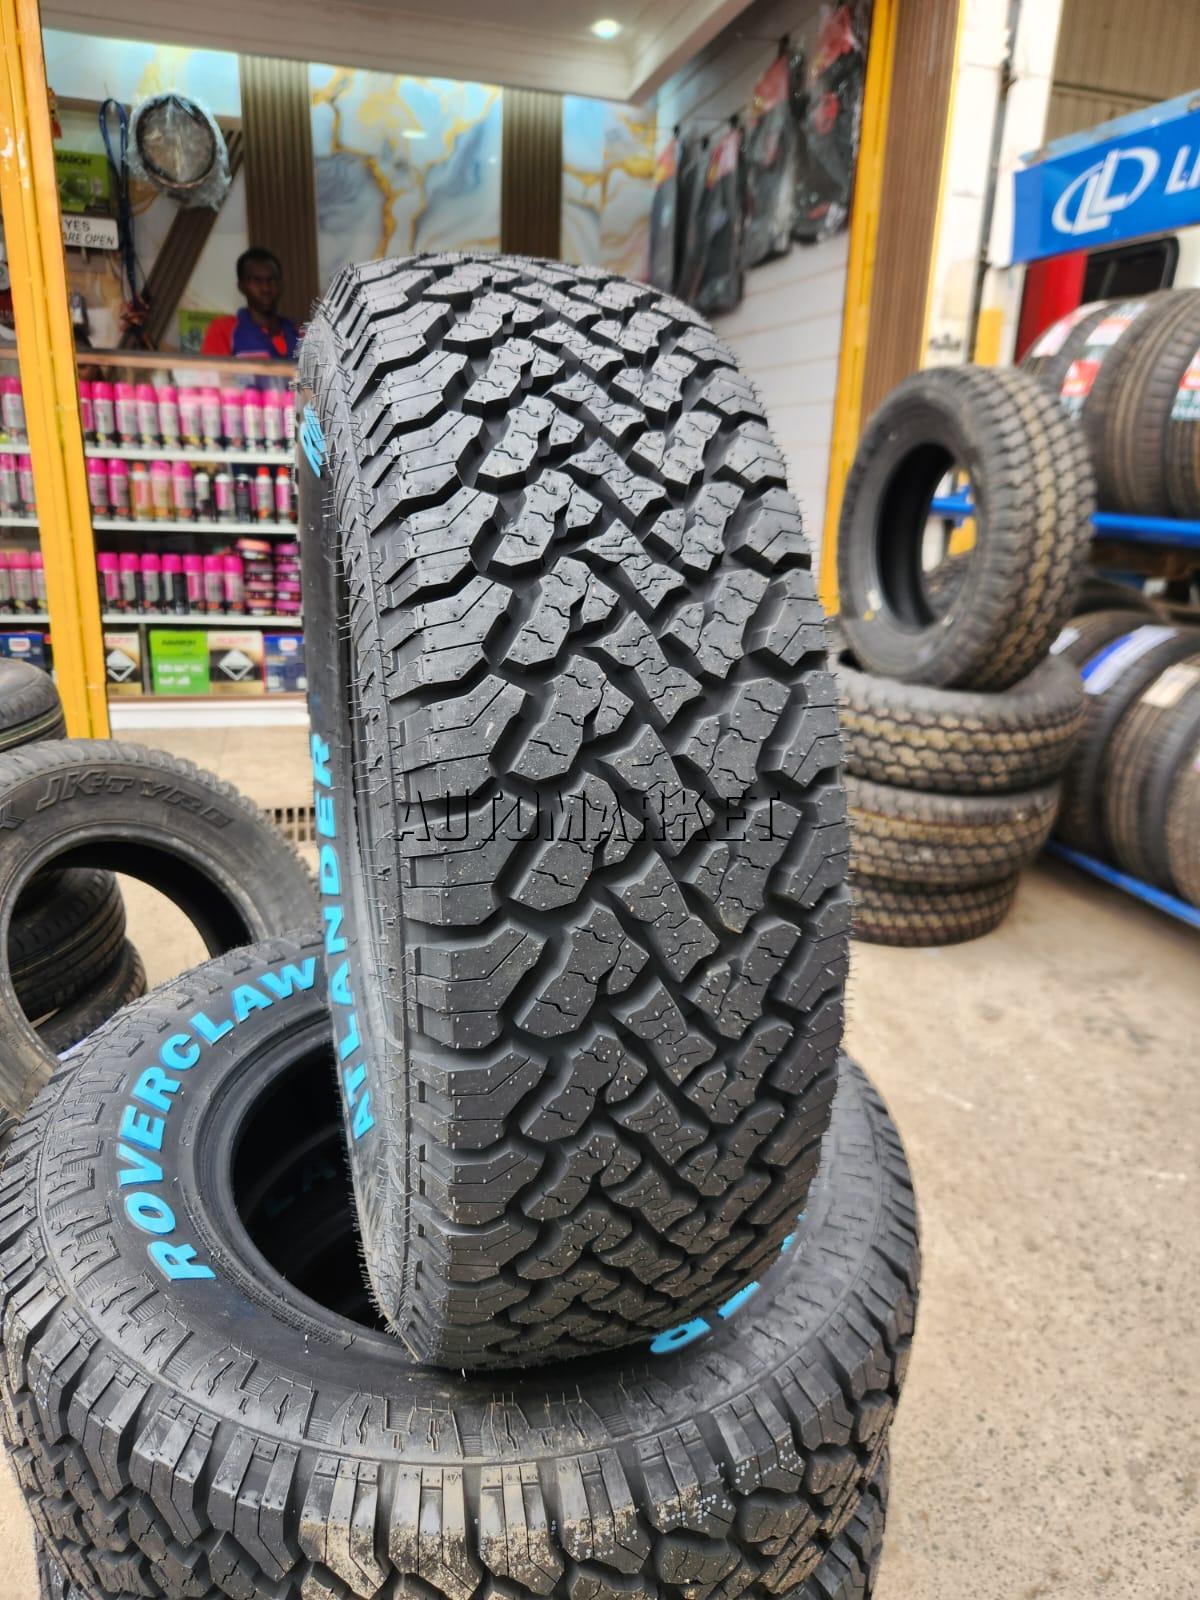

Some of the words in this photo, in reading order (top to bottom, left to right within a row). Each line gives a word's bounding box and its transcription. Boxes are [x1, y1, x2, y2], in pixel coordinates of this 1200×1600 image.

[64, 219, 91, 232] YES
[84, 233, 115, 247] OPEN
[311, 733, 376, 1140] ATLANDER
[117, 956, 316, 1281] ROVERCLAW
